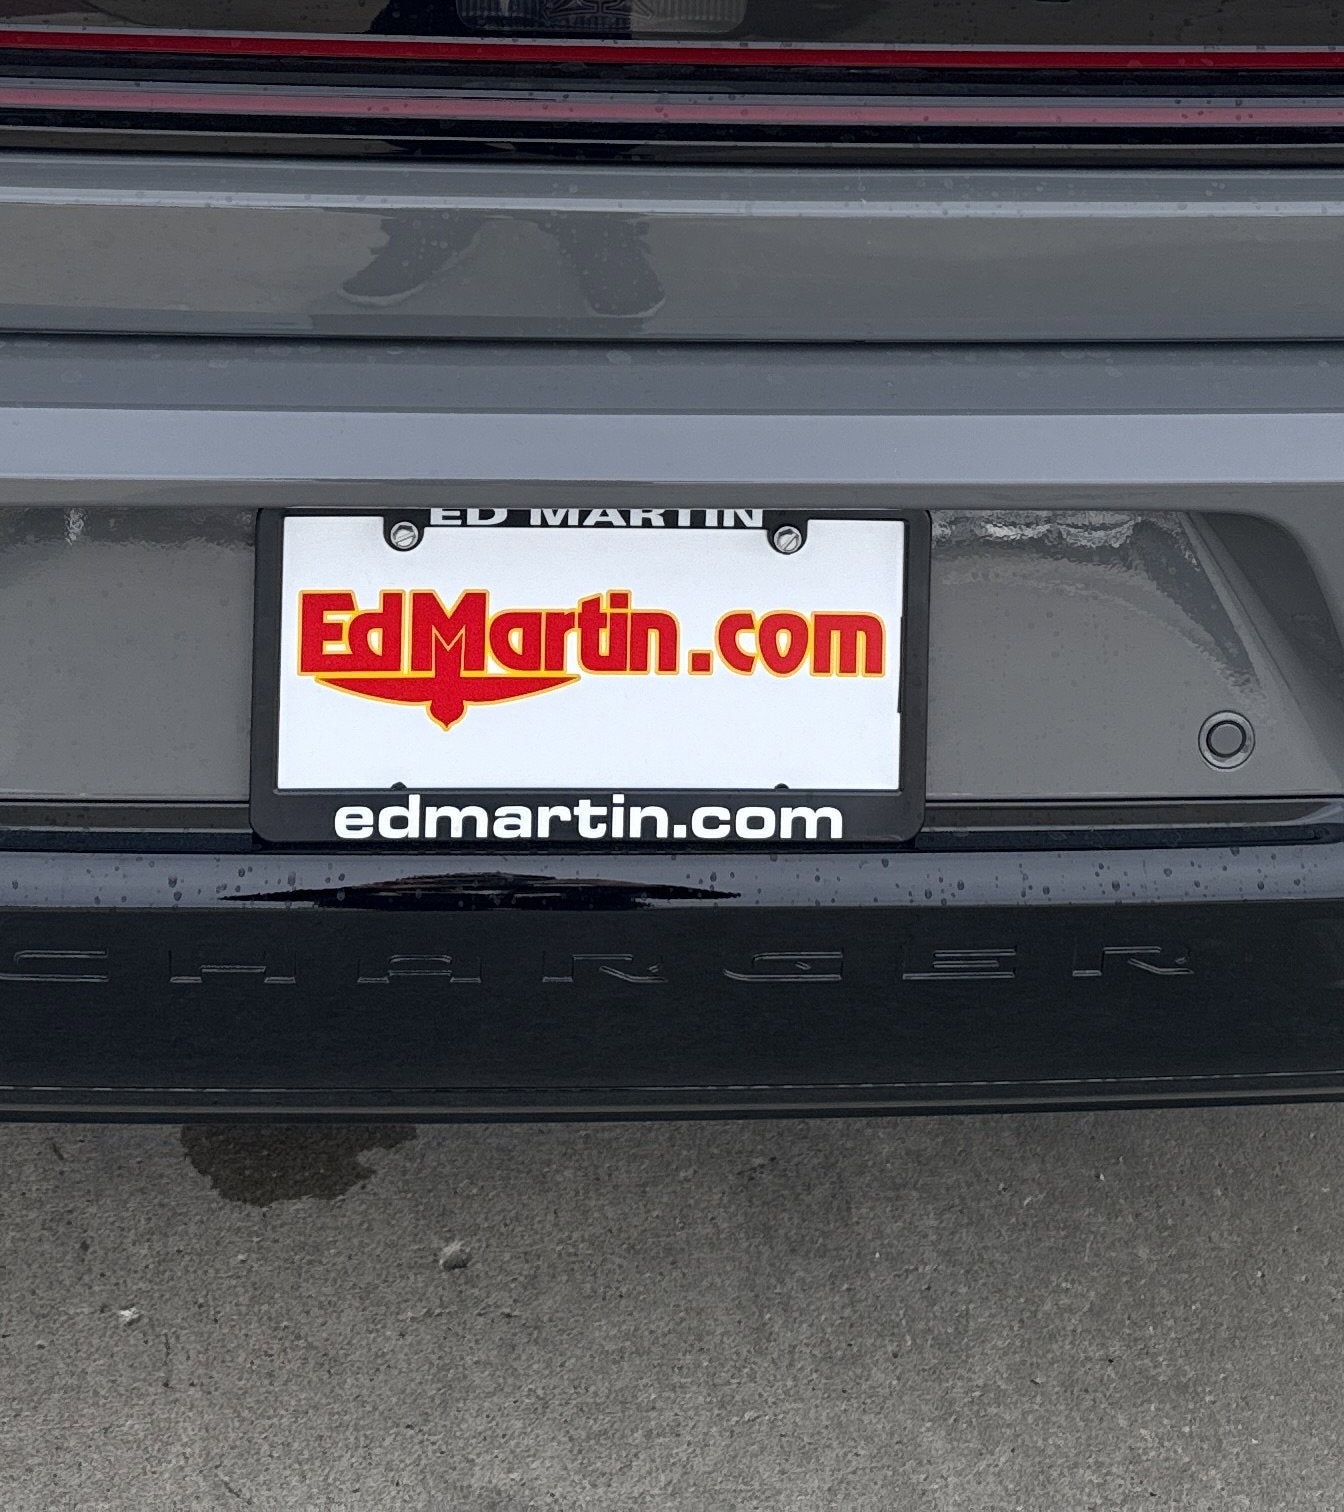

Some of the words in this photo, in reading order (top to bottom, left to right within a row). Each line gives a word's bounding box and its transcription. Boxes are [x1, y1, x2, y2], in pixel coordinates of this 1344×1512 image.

[430, 508, 508, 526] ED
[530, 508, 764, 528] MARTIN
[296, 588, 887, 678] EdMartin.com
[333, 793, 844, 840] edmartin.com
